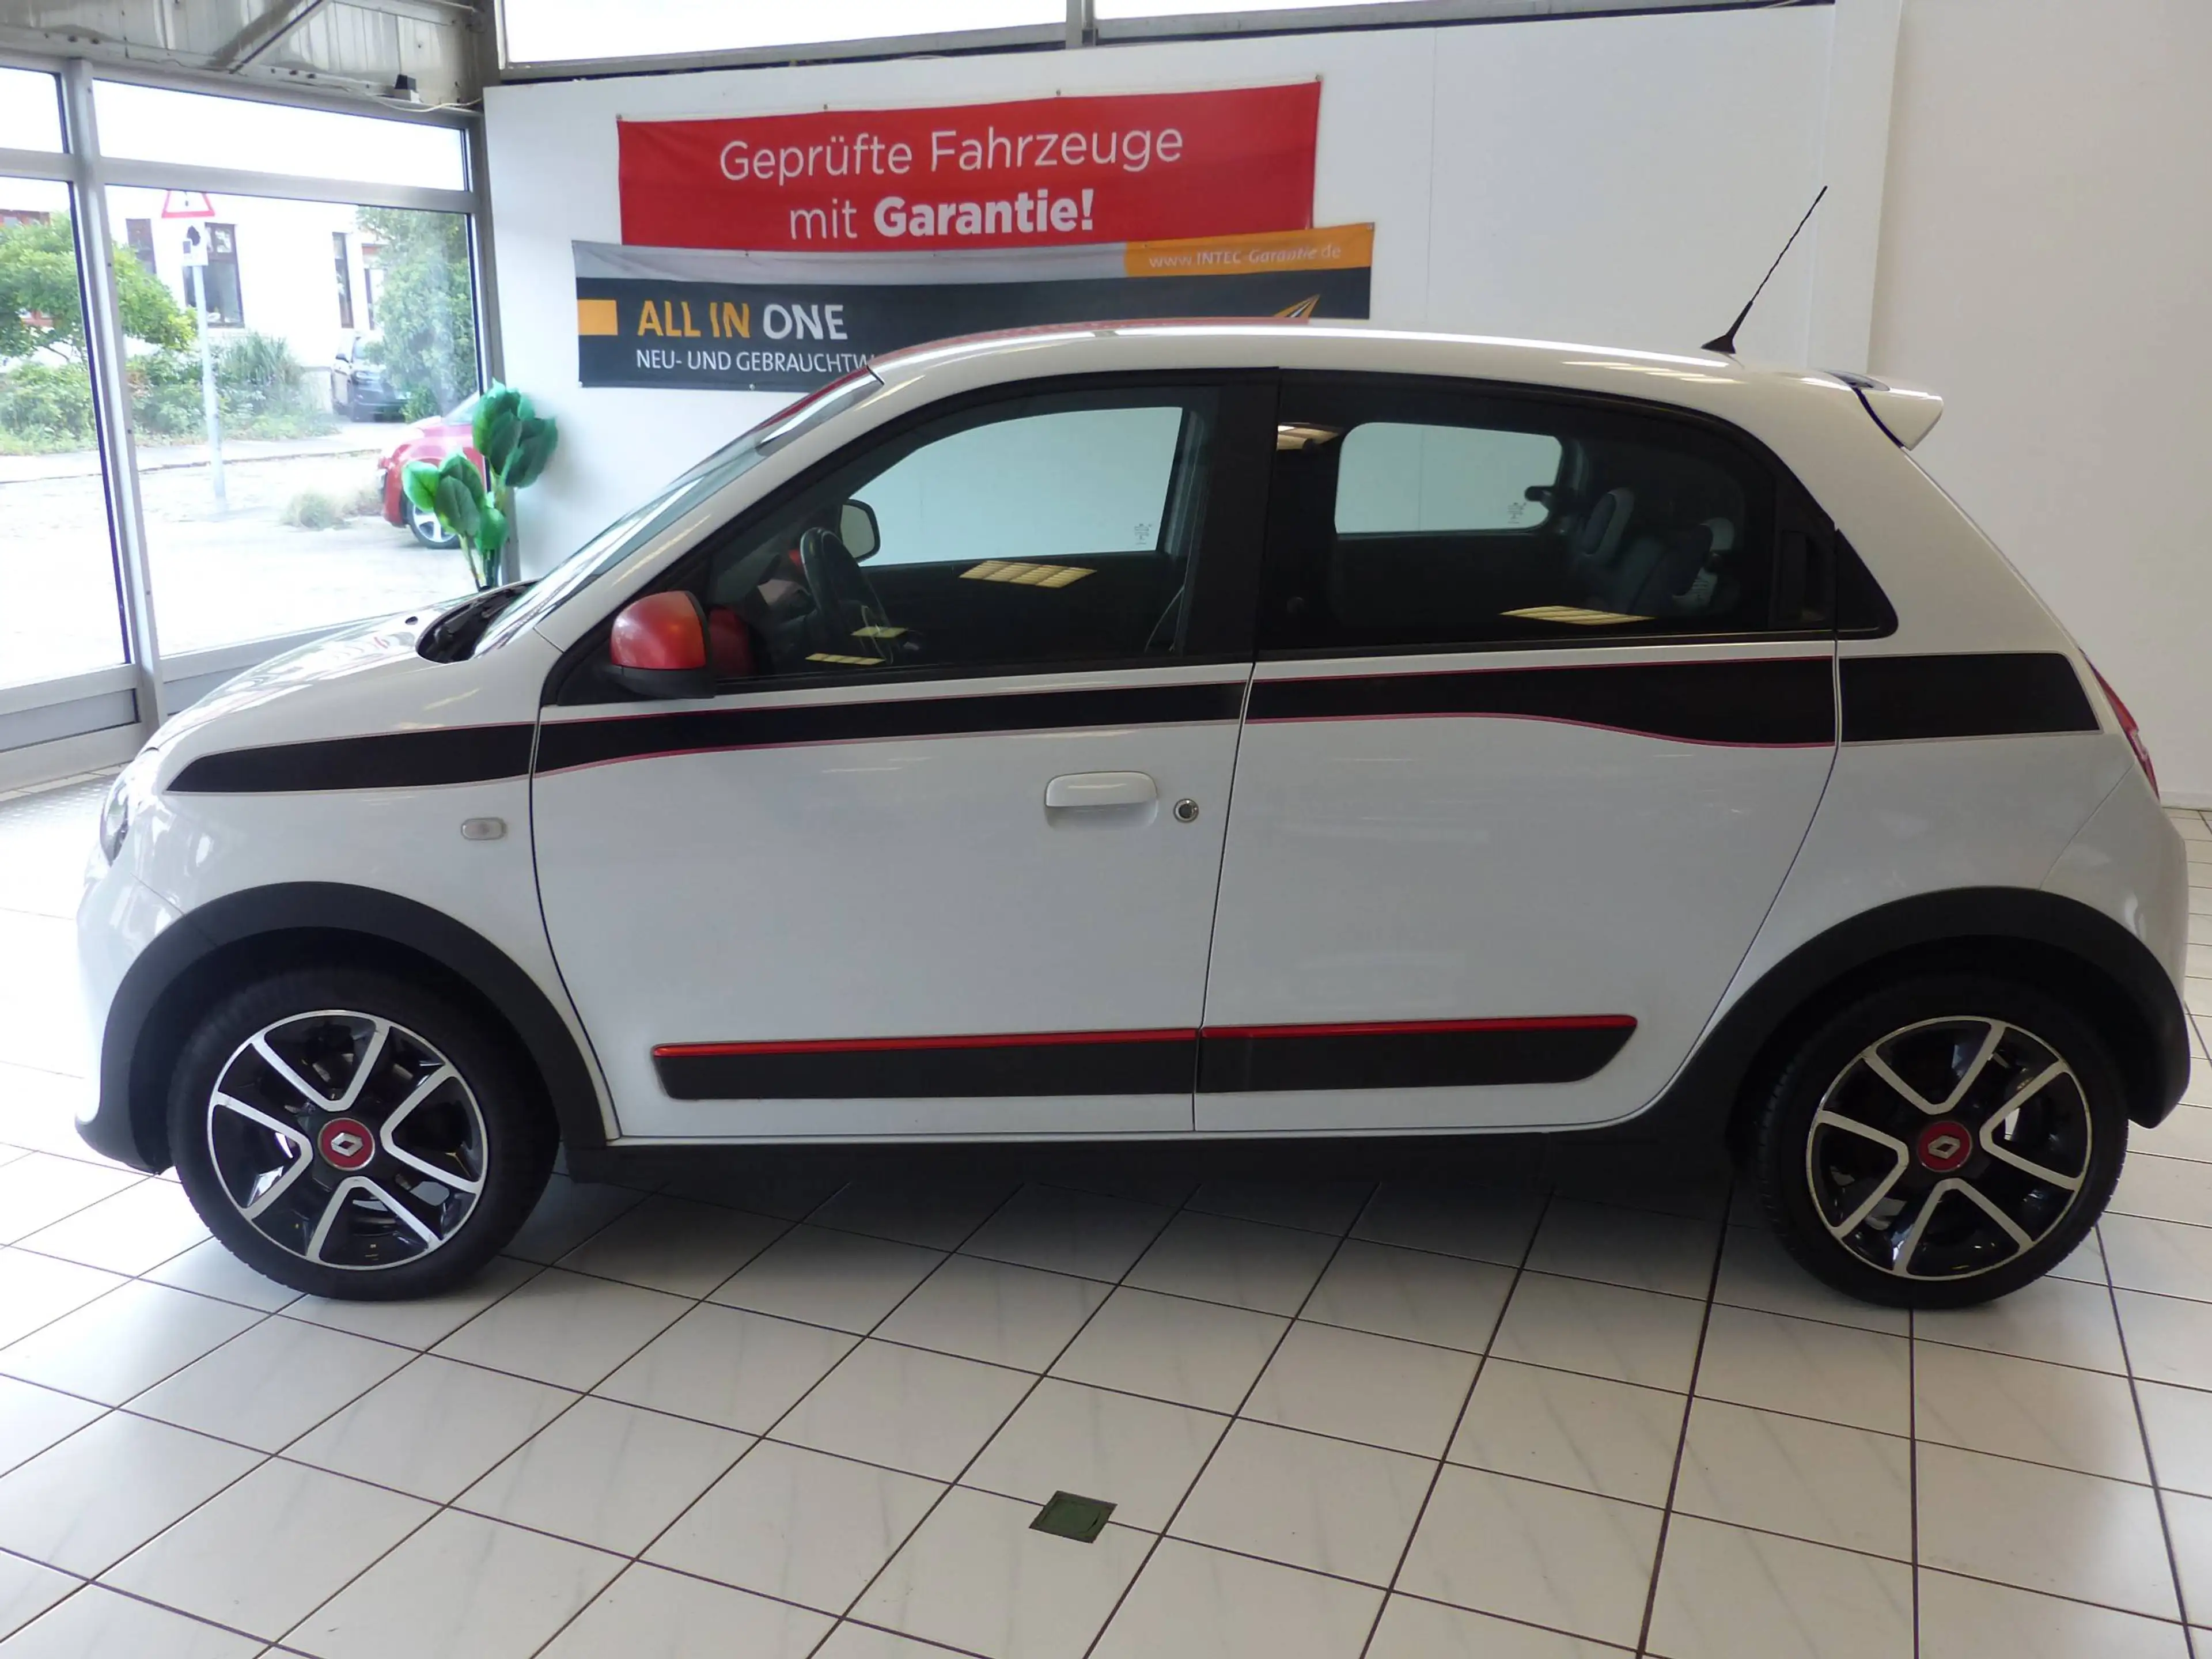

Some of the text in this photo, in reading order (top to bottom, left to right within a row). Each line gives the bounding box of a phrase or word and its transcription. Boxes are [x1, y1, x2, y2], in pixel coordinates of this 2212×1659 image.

[719, 126, 1183, 186] Geprüfte Fahrzeuge
[790, 188, 1094, 240] mit Garantie!
[637, 300, 848, 340] ALL IN ONE
[636, 349, 682, 370] NEU-
[687, 351, 731, 371] UND
